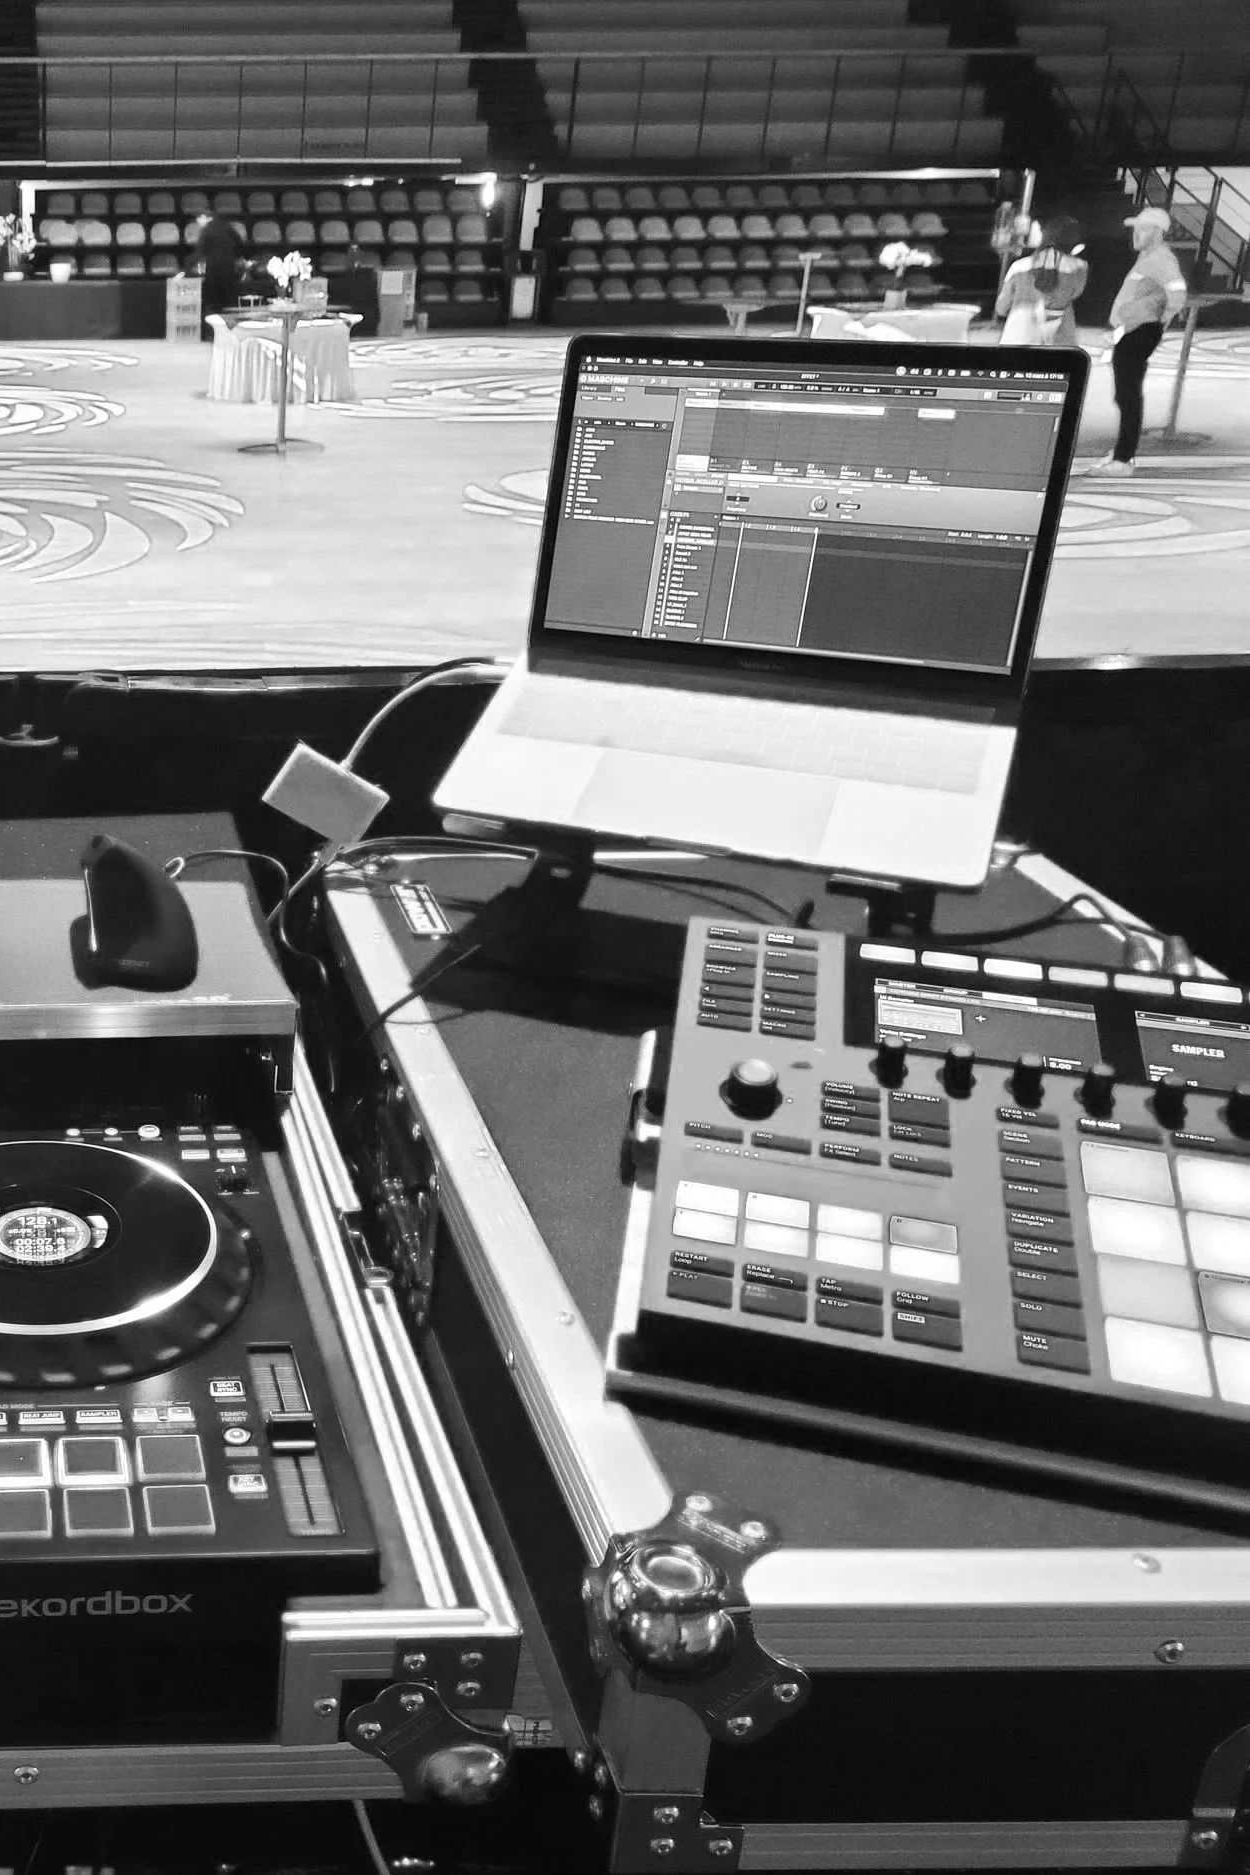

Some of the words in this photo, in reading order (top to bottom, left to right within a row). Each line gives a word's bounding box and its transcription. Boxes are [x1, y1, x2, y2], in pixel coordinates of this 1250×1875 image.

[587, 375, 630, 385] MASCHINE
[581, 385, 597, 393] Library
[764, 1006, 796, 1015] SETTINGS
[1175, 1016, 1210, 1026] SAMPLER
[1172, 1044, 1225, 1058] SAMPLER
[1149, 1064, 1174, 1073] Engine
[826, 1081, 854, 1090] VOLUME
[892, 1091, 911, 1099] NOTE
[913, 1094, 941, 1102] REPEAT
[825, 1098, 848, 1106] SWING
[824, 1104, 856, 1112] [Position]
[1000, 1107, 1022, 1115] FIXED
[825, 1114, 850, 1122] TEMPO
[689, 1122, 711, 1130] PITCH
[893, 1124, 913, 1132] LOCK
[1002, 1131, 1028, 1139] SCENE
[1003, 1135, 1030, 1144] Section
[1175, 1132, 1216, 1142] KEYBOARD
[824, 1143, 860, 1152] PERFORM
[893, 1154, 919, 1163] NOTES
[1005, 1157, 1041, 1167] PATTERN
[1008, 1184, 1039, 1194] EVENTS
[18, 1216, 58, 1226] 128.1
[1011, 1211, 1055, 1224] VARIATION
[1011, 1217, 1045, 1227] Navigate
[1013, 1241, 1059, 1253] DUPLICATE
[1014, 1246, 1041, 1256] Double
[674, 1251, 709, 1262] RESTART
[746, 1264, 771, 1273] ERASE
[679, 1272, 699, 1280] PLAY
[746, 1270, 776, 1280] Replace
[1017, 1271, 1047, 1281] SELECT
[820, 1282, 842, 1292] Metro
[896, 1291, 929, 1302] FOLLOW
[827, 1300, 849, 1308] STOP
[1020, 1302, 1043, 1311] SOLO
[899, 1313, 924, 1322] SHIFT
[1022, 1335, 1047, 1344] MUTE
[1023, 1340, 1049, 1351] Choke
